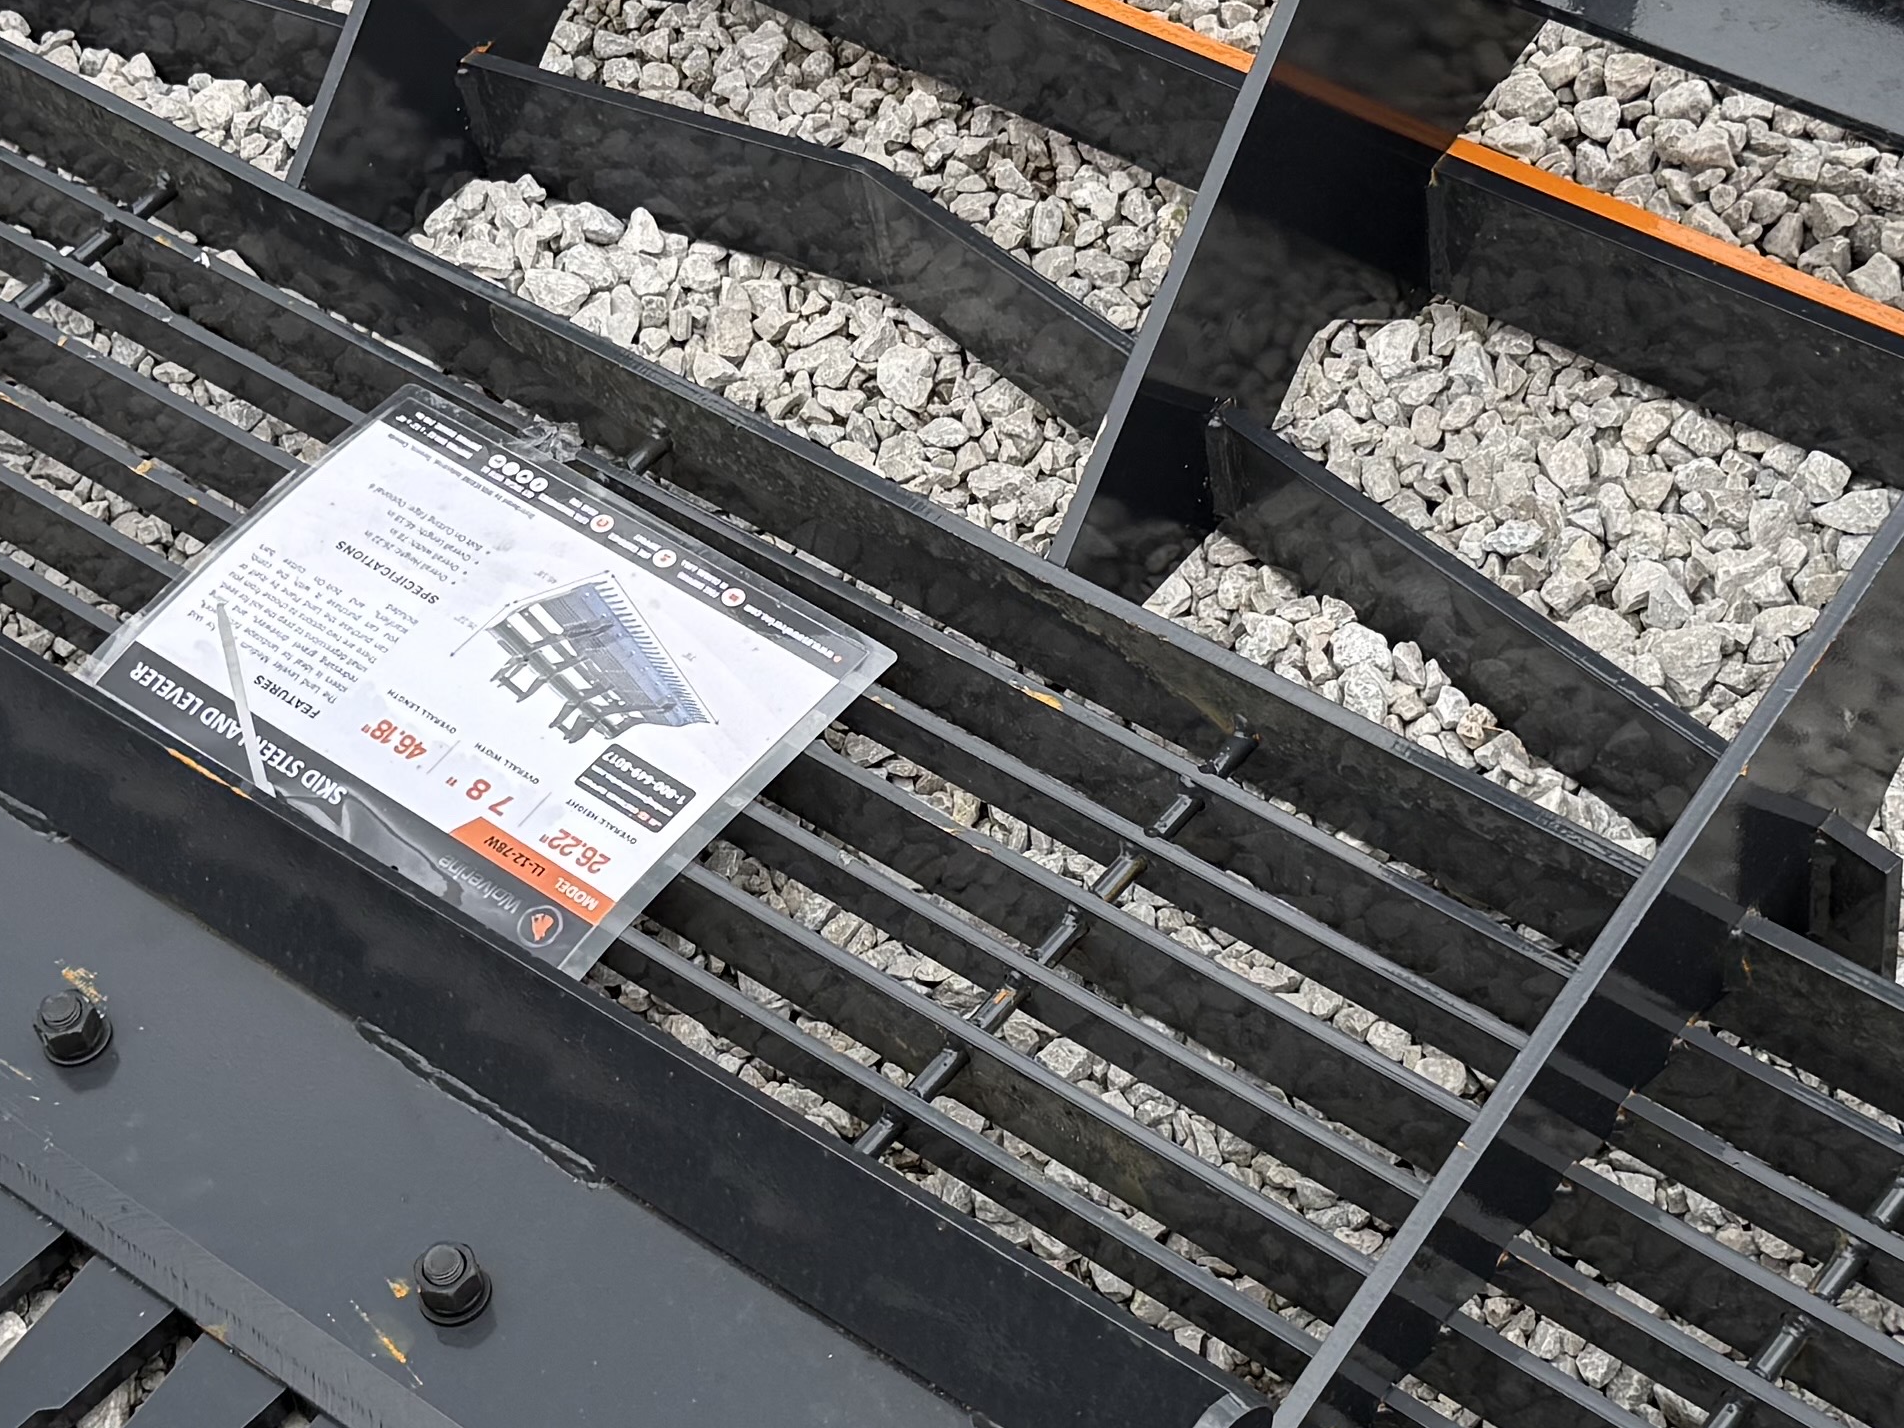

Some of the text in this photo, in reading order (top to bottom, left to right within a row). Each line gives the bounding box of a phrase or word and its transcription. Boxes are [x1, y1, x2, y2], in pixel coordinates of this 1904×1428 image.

[332, 539, 441, 604] SPECIFICATIONS
[124, 661, 207, 715] LEVELER
[251, 674, 321, 718] FEATURES
[298, 677, 322, 693] Land
[320, 690, 338, 704] The
[385, 688, 458, 734] OVERALL LENGTH
[358, 713, 431, 763] 46.18"
[296, 767, 351, 805] SKID
[501, 759, 541, 785] OVERALL
[536, 823, 612, 875] 26.22"
[597, 817, 638, 844] OVERALL
[432, 852, 527, 914] Wolverine
[481, 834, 601, 911] MODEL LL-12-78W
